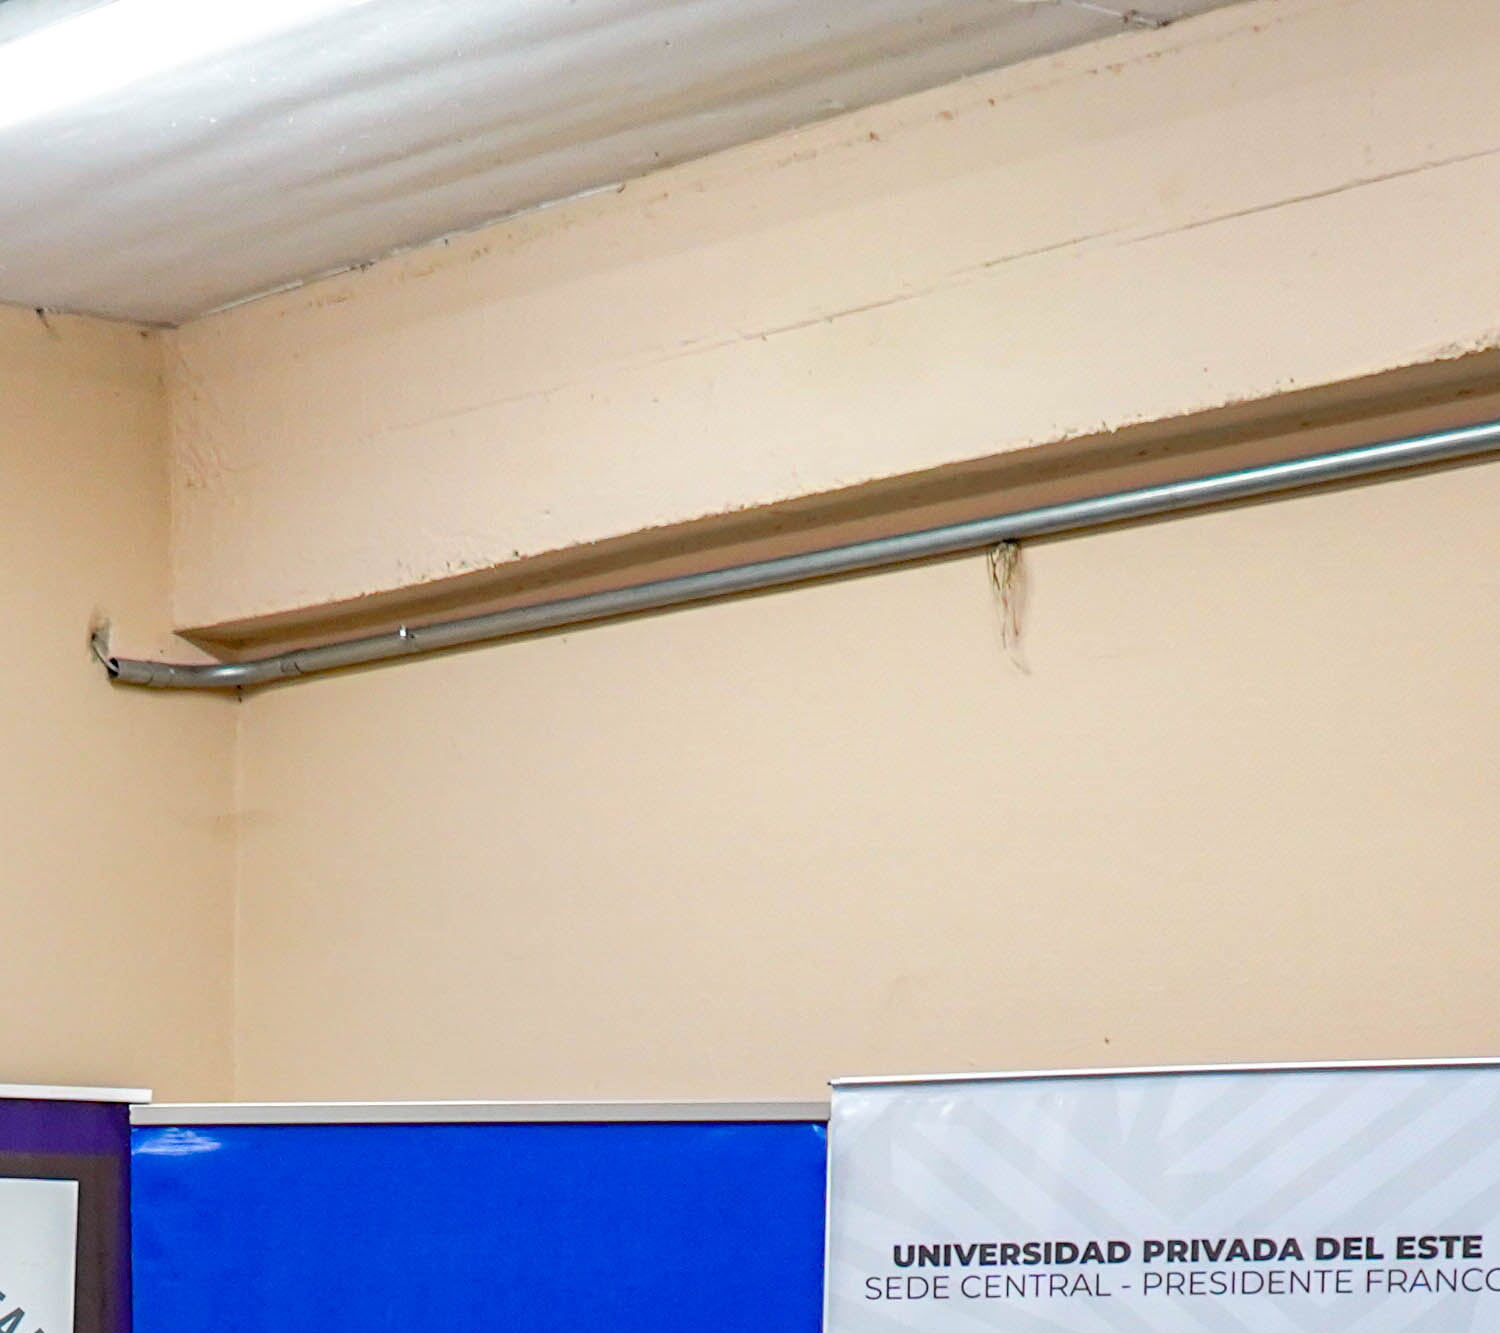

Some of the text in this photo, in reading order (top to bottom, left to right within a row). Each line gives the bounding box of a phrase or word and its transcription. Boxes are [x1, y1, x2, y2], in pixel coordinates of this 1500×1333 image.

[893, 1234, 1482, 1268] UNIVERSIDAD PRIVADA DEL ESTE
[865, 1275, 949, 1300] SEDE
[960, 1273, 1111, 1299] CENTRAL
[1143, 1269, 1352, 1296] PRESIDENTE
